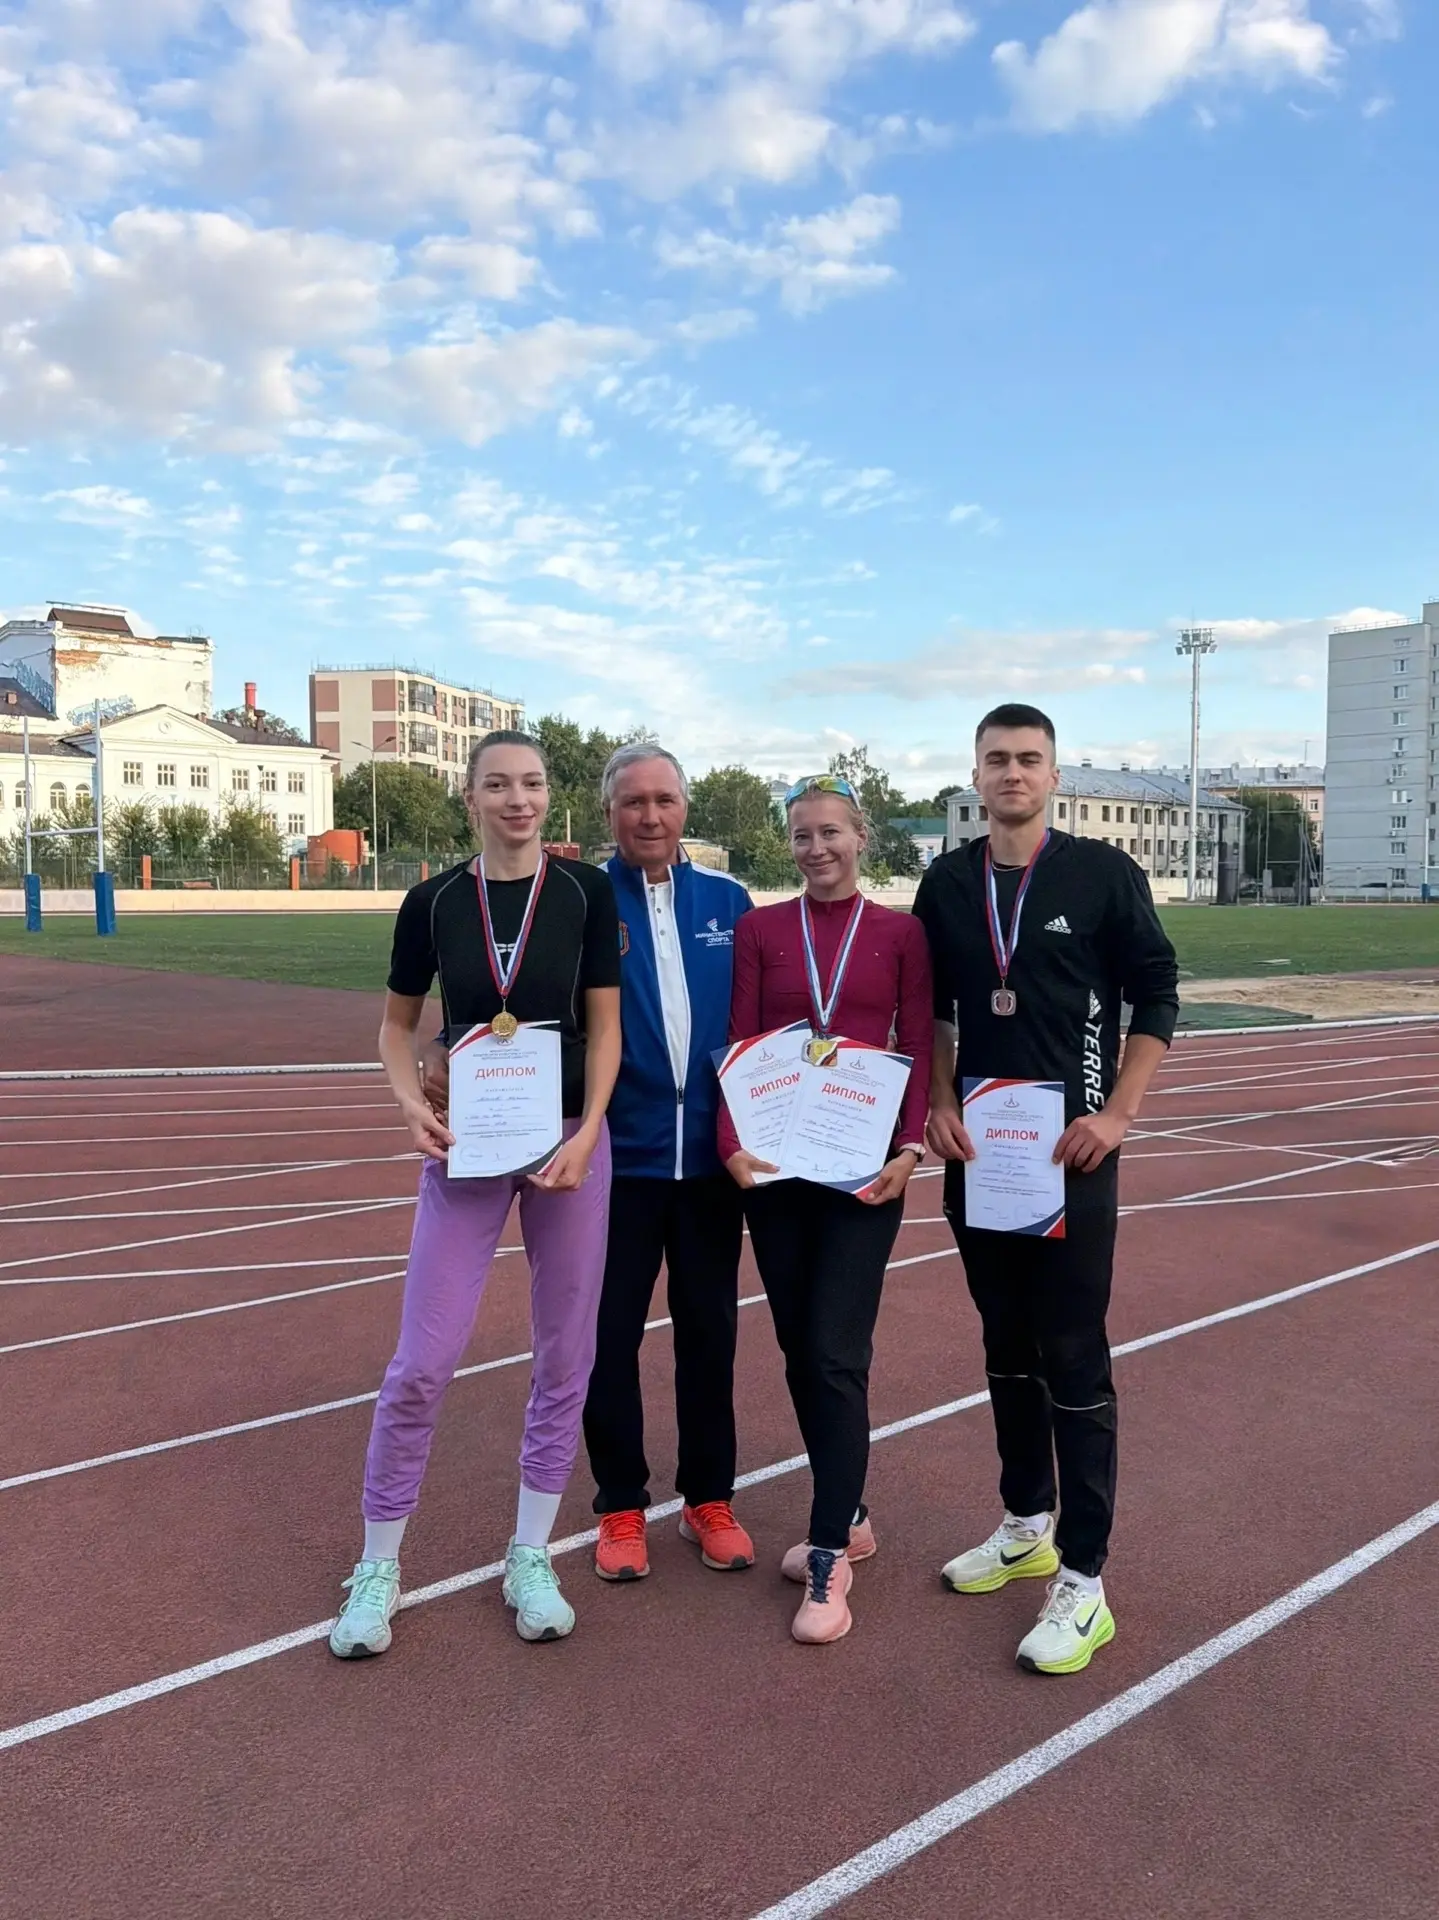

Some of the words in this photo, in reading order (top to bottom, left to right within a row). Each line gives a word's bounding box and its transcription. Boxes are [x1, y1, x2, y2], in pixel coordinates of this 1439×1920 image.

[1044, 924, 1072, 935] adidas
[475, 1066, 536, 1080] ДИПЛОМ
[750, 1072, 801, 1099] ДИПЛОМ
[821, 1082, 876, 1106] ДИПЛОМ
[985, 1128, 1039, 1141] ДИПЛОМ
